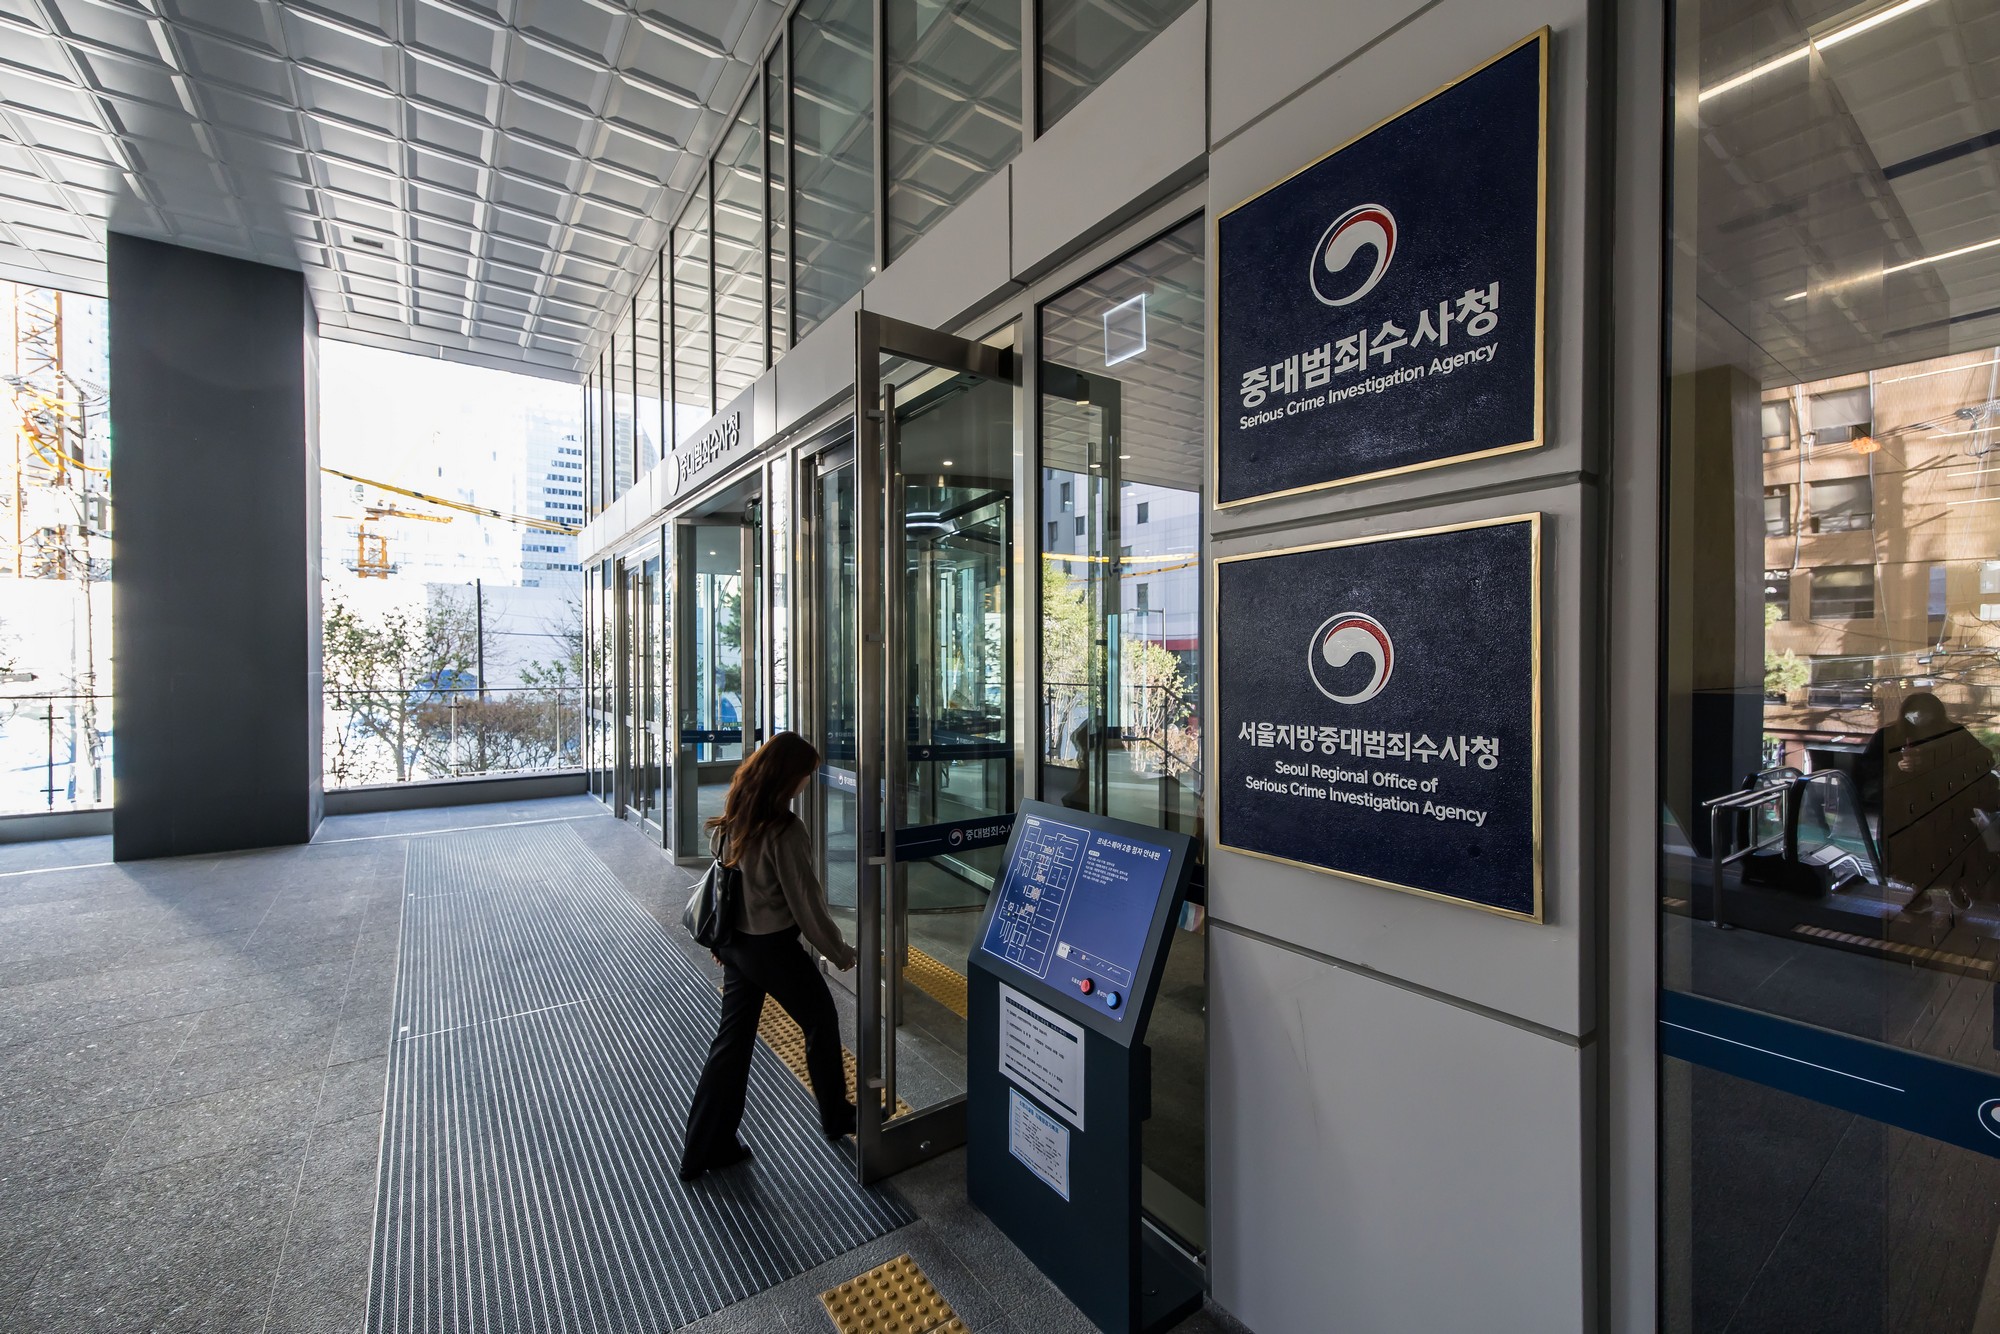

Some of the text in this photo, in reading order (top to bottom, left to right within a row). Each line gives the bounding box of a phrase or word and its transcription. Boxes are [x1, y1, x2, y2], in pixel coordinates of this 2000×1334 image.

[1239, 281, 1499, 408] 중대범죄수사청
[1239, 343, 1499, 430] Serious Crime Investigation Agency
[680, 411, 740, 482] 중대범죄수사청
[1238, 721, 1499, 770] 서울지방중대범죄수사청
[1245, 775, 1488, 827] Serious Crime Investigation Agency
[1275, 761, 1439, 793] Seoul Regional Office of
